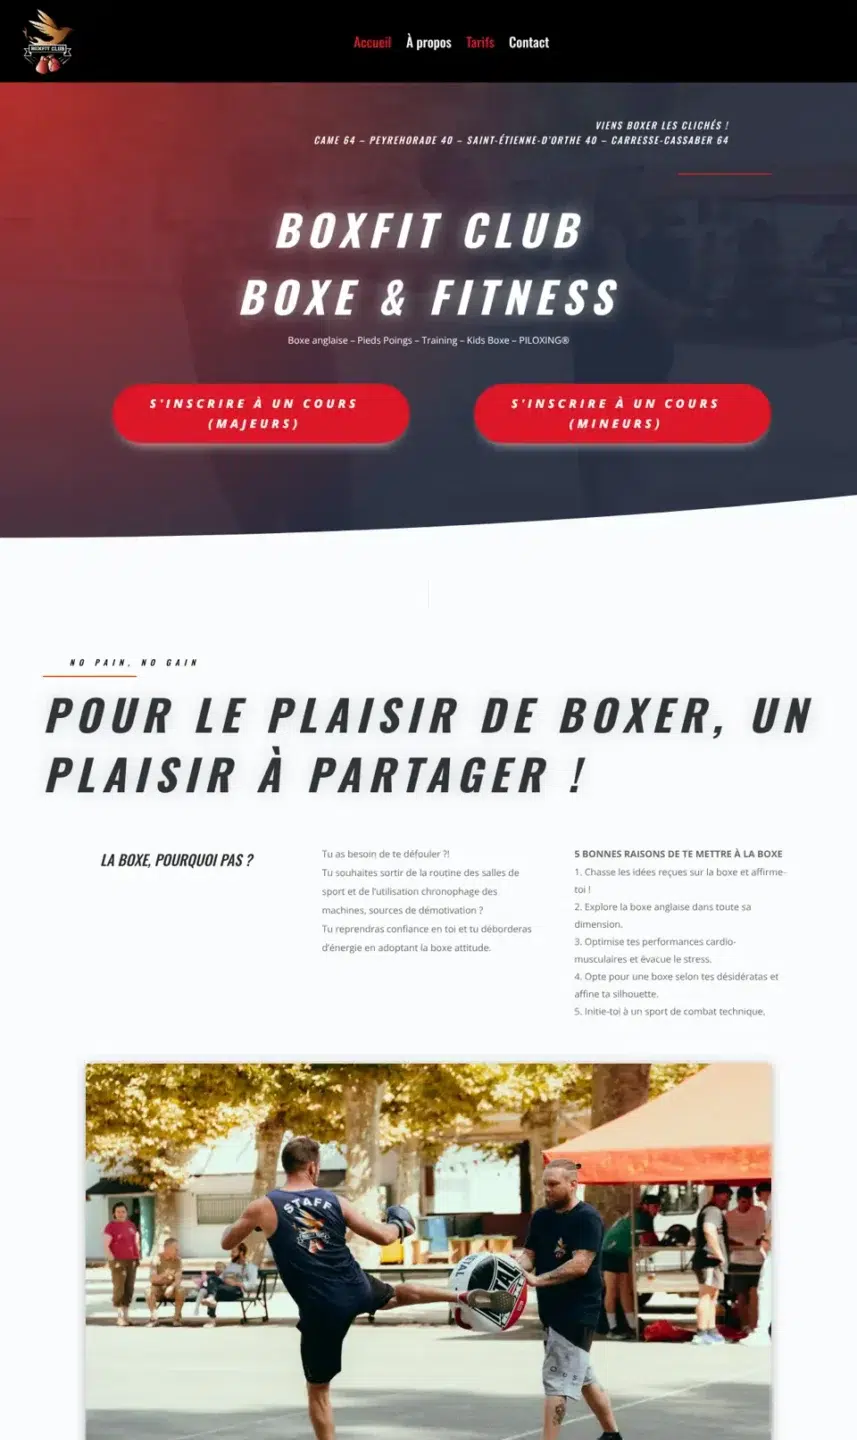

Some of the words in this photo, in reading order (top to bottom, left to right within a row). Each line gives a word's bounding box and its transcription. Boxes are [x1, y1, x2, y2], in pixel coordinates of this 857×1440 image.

[353, 35, 392, 49] Accueil
[406, 32, 414, 48] À
[416, 39, 452, 51] propos
[466, 36, 495, 49] Tarifs
[509, 36, 550, 49] Contact
[595, 121, 623, 130] VIENS
[626, 121, 658, 130] BOXER
[661, 121, 678, 130] LES
[681, 119, 722, 130] CLICHÉS
[725, 121, 729, 130] !
[313, 135, 340, 145] CAME
[343, 135, 356, 145] 64
[369, 135, 437, 145] PEYREHORADE
[440, 135, 453, 145] 40
[466, 133, 582, 145] SAINT-ÉTIENNE-D'ORTHE
[585, 135, 598, 145] 40
[611, 135, 713, 145] CARRESSE-CASSABER
[716, 135, 729, 145] 64
[275, 212, 442, 249] BOXFIT
[464, 212, 581, 249] CLUB
[240, 279, 359, 316] BOXE
[380, 279, 405, 316] &
[431, 279, 617, 316] FITNESS
[287, 336, 311, 345] Boxe
[311, 336, 349, 347] anglaise
[357, 336, 381, 345] Pieds
[383, 336, 413, 347] Poings
[421, 336, 458, 347] Training
[466, 335, 486, 345] Kids
[487, 336, 510, 345] Boxe
[518, 335, 570, 345] PILOXING®
[149, 398, 245, 409] S'INSCRIRE
[253, 396, 262, 409] À
[272, 398, 294, 409] UN
[302, 398, 356, 409] COURS
[511, 398, 607, 409] S'INSCRIRE
[614, 396, 624, 409] À
[633, 398, 656, 409] UN
[664, 398, 718, 409] COURS
[208, 418, 298, 432] (MAJEURS)
[569, 418, 660, 431] (MINEURS)
[69, 658, 85, 667] NO
[94, 658, 130, 667] PAIN,
[141, 658, 156, 667] NO
[166, 658, 197, 667] GAIN
[45, 697, 172, 734] POUR
[195, 697, 247, 734] LE
[267, 697, 458, 734] PLAISIR
[480, 697, 539, 734] DE
[559, 697, 723, 739] BOXER,
[752, 697, 812, 734] UN
[45, 756, 235, 794] PLAISIR
[256, 745, 282, 793] À
[308, 756, 547, 794] PARTAGER
[569, 757, 586, 793] !
[322, 849, 333, 859] Tu
[335, 851, 346, 859] as
[347, 849, 377, 859] besoin
[378, 849, 391, 859] de
[392, 851, 402, 859] te
[403, 849, 441, 859] défouler
[442, 849, 450, 858] ?!
[574, 850, 580, 858] 5
[582, 849, 622, 858] BONNES
[624, 850, 666, 858] RAISONS
[667, 850, 680, 858] DE
[682, 850, 693, 858] TE
[695, 849, 732, 858] METTRE
[734, 848, 741, 858] À
[743, 850, 755, 858] LA
[757, 849, 783, 858] BOXE
[100, 853, 115, 867] LA
[118, 853, 151, 868] BOXE,
[155, 853, 219, 869] POURQUOI
[220, 853, 244, 867] PAS
[246, 853, 255, 867] ?
[574, 920, 623, 929] dimension.
[574, 989, 600, 999] affine
[601, 990, 611, 999] ta
[612, 989, 659, 999] silhouette.
[283, 1197, 332, 1214] STAFF
